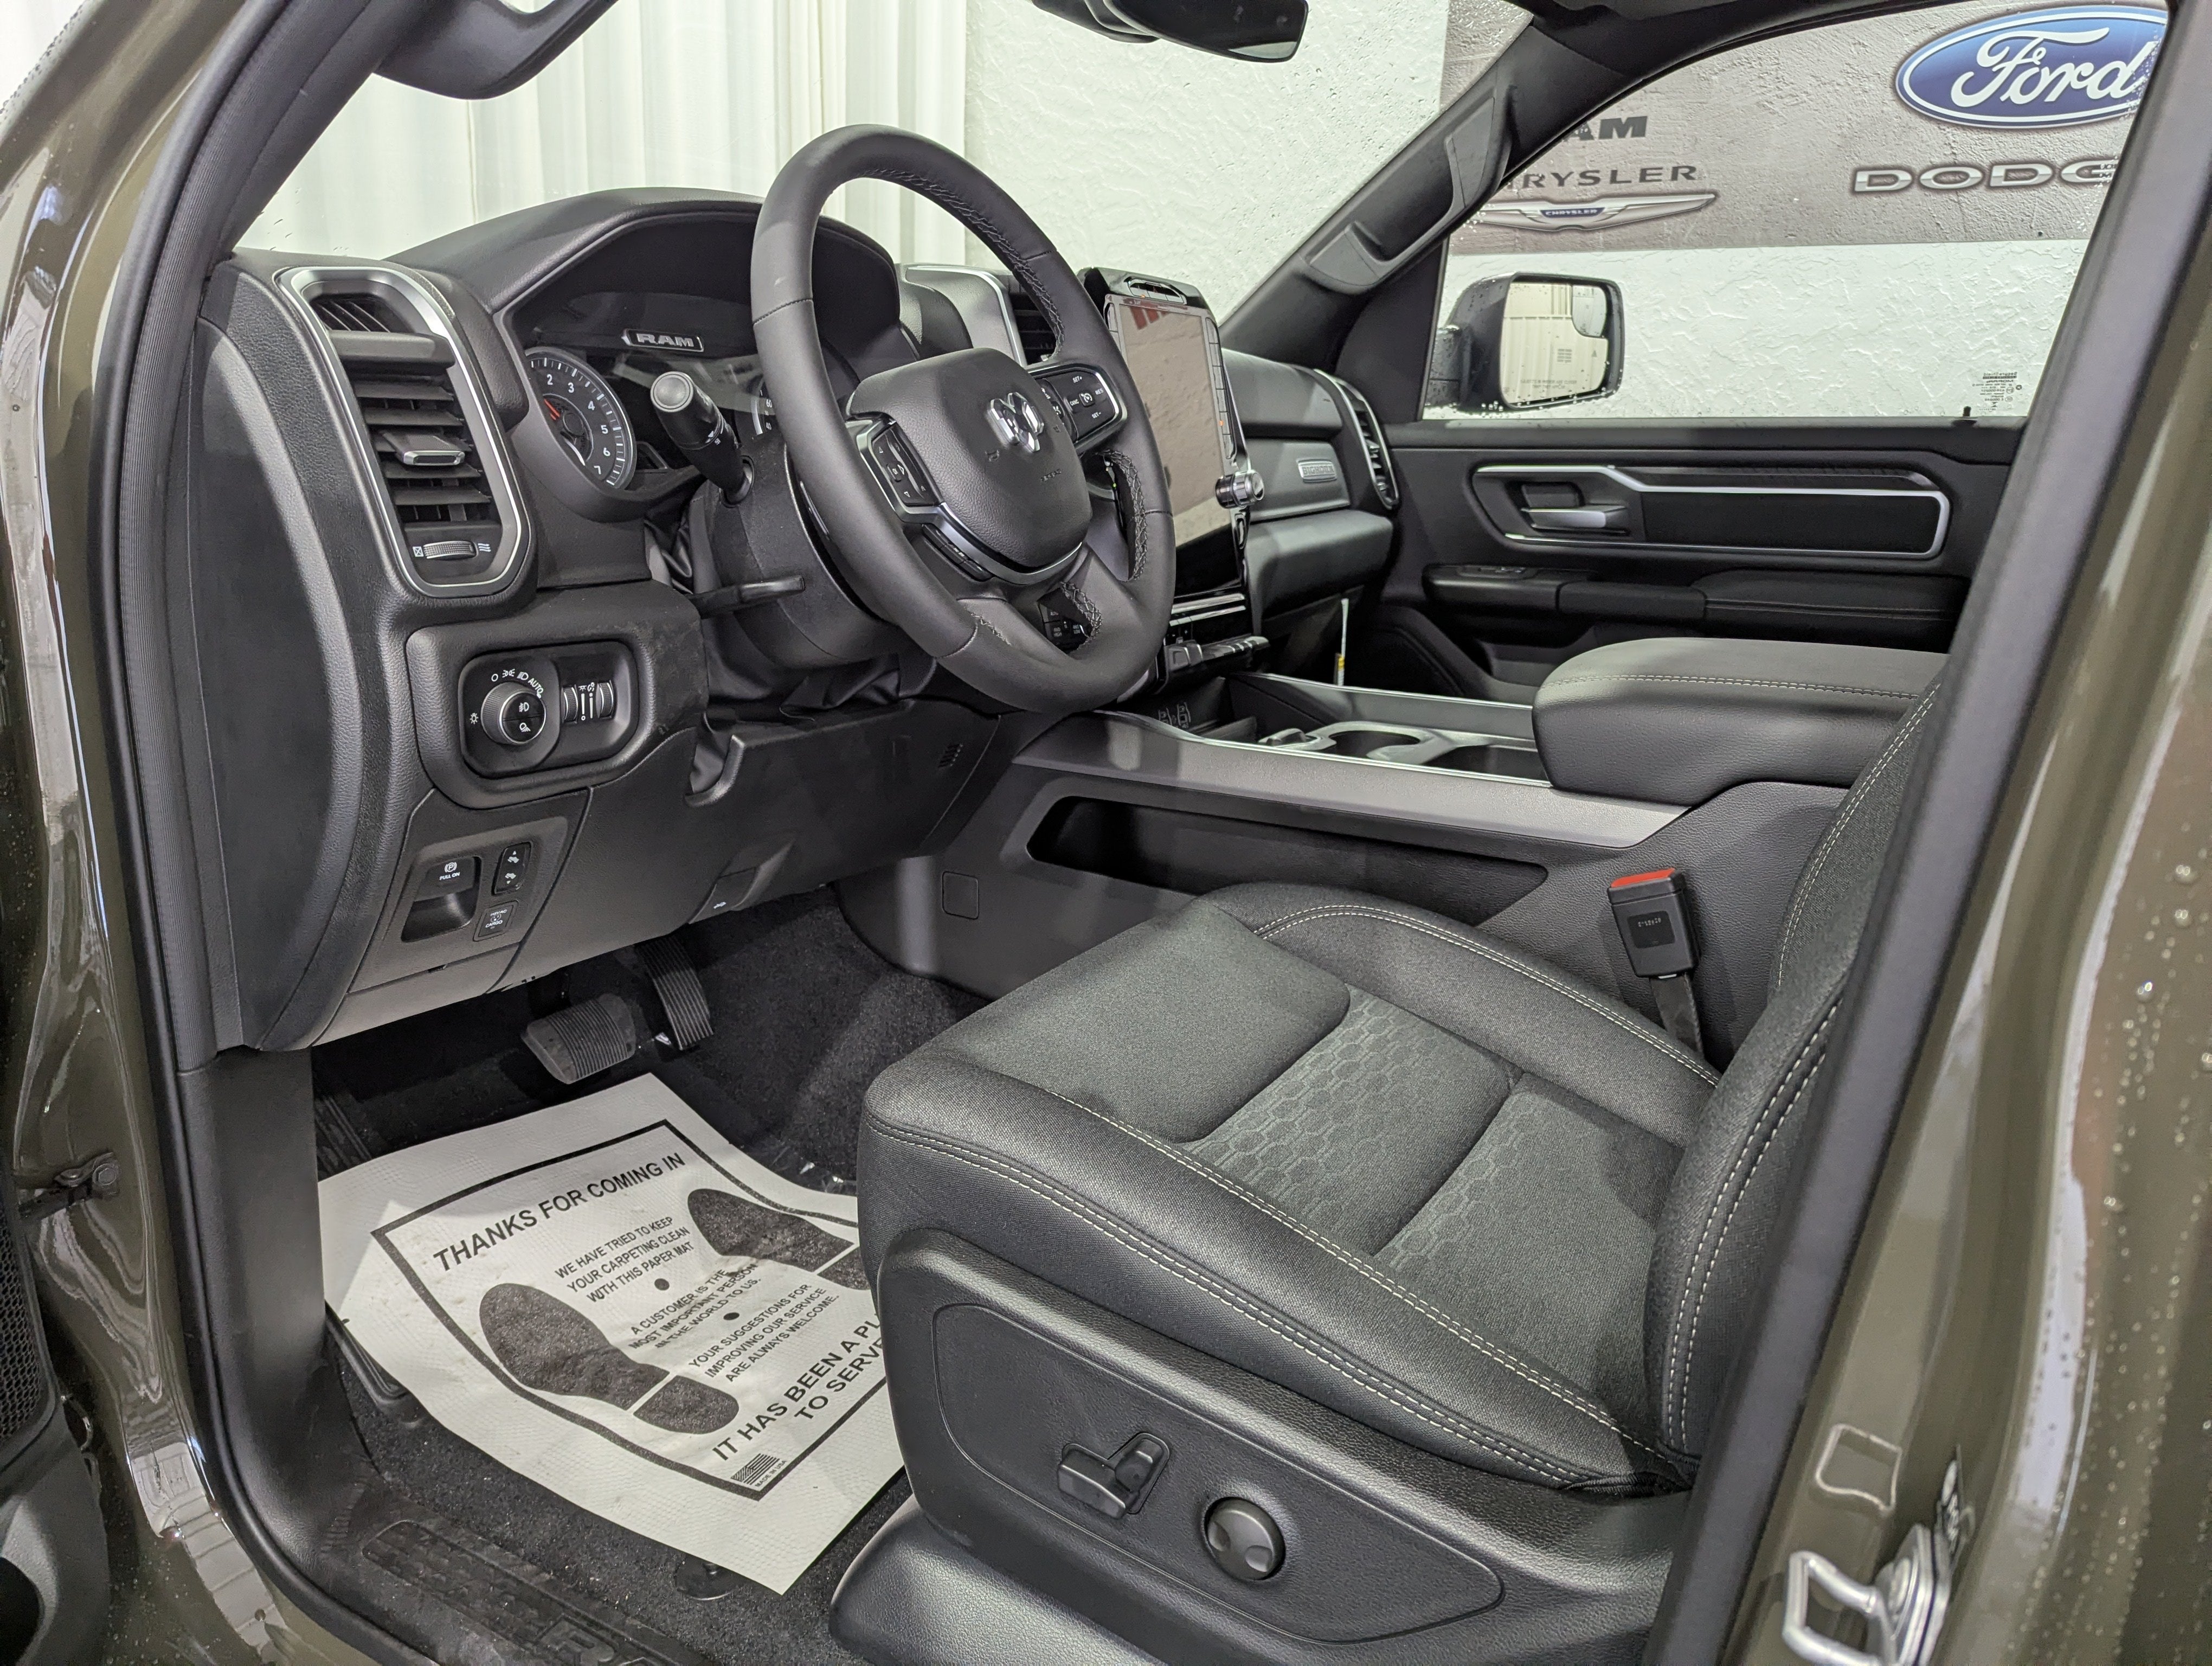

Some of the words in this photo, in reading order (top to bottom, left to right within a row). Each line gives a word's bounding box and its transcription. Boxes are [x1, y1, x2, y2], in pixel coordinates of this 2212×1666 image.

[1951, 27, 2160, 107] Ford
[1564, 116, 1648, 141] AM
[1507, 165, 1697, 190] RYSLER
[1854, 159, 2117, 192] DODG
[636, 333, 695, 347] RAM
[546, 374, 554, 386] 2
[568, 382, 575, 393] 3
[588, 400, 595, 411] 4
[600, 425, 609, 434] 5
[603, 447, 610, 457] 6
[594, 465, 601, 475] 7
[528, 677, 544, 694] AUTO
[433, 1210, 537, 1272] THANKS
[538, 1190, 588, 1219] FOR
[587, 1162, 664, 1198] COMING
[662, 1152, 686, 1171] IN
[555, 1262, 577, 1279] WE
[575, 1246, 607, 1268] HAVE
[605, 1232, 637, 1251] TRIED
[634, 1226, 651, 1237] TO
[648, 1216, 673, 1232] KEEP
[567, 1269, 603, 1292] YOUR
[601, 1240, 660, 1274] CARPETING
[658, 1226, 691, 1244] CLEAN
[586, 1280, 619, 1303] WITH
[615, 1267, 644, 1285] THIS
[641, 1250, 676, 1272] PAPER
[672, 1241, 695, 1256] MAT
[628, 1330, 662, 1349] MOST
[659, 1292, 719, 1331] IMPORTANT
[716, 1264, 759, 1292] PERSON
[631, 1326, 642, 1335] A
[639, 1293, 698, 1329] CUSTOMER
[695, 1285, 709, 1295] IS
[705, 1269, 730, 1286] THE
[667, 1325, 694, 1340] THE
[689, 1299, 729, 1326] WORLD
[725, 1289, 743, 1299] TO
[689, 1345, 724, 1368] YOUR
[720, 1298, 792, 1346] SUGGESTIONS
[705, 1334, 765, 1378] IMPROVING
[762, 1318, 788, 1334] OUR
[784, 1288, 827, 1319] SERVICE
[725, 1361, 751, 1382] ARE
[748, 1332, 790, 1363] ALWAYS
[786, 1295, 840, 1334] WELCOME.
[712, 1437, 738, 1461] IT
[737, 1402, 788, 1441] HAS
[783, 1352, 844, 1403] BEEN
[840, 1340, 860, 1354] A
[853, 1313, 881, 1339] PL
[794, 1395, 829, 1420] TO
[754, 1476, 771, 1488] MADE
[775, 1460, 787, 1470] USA
